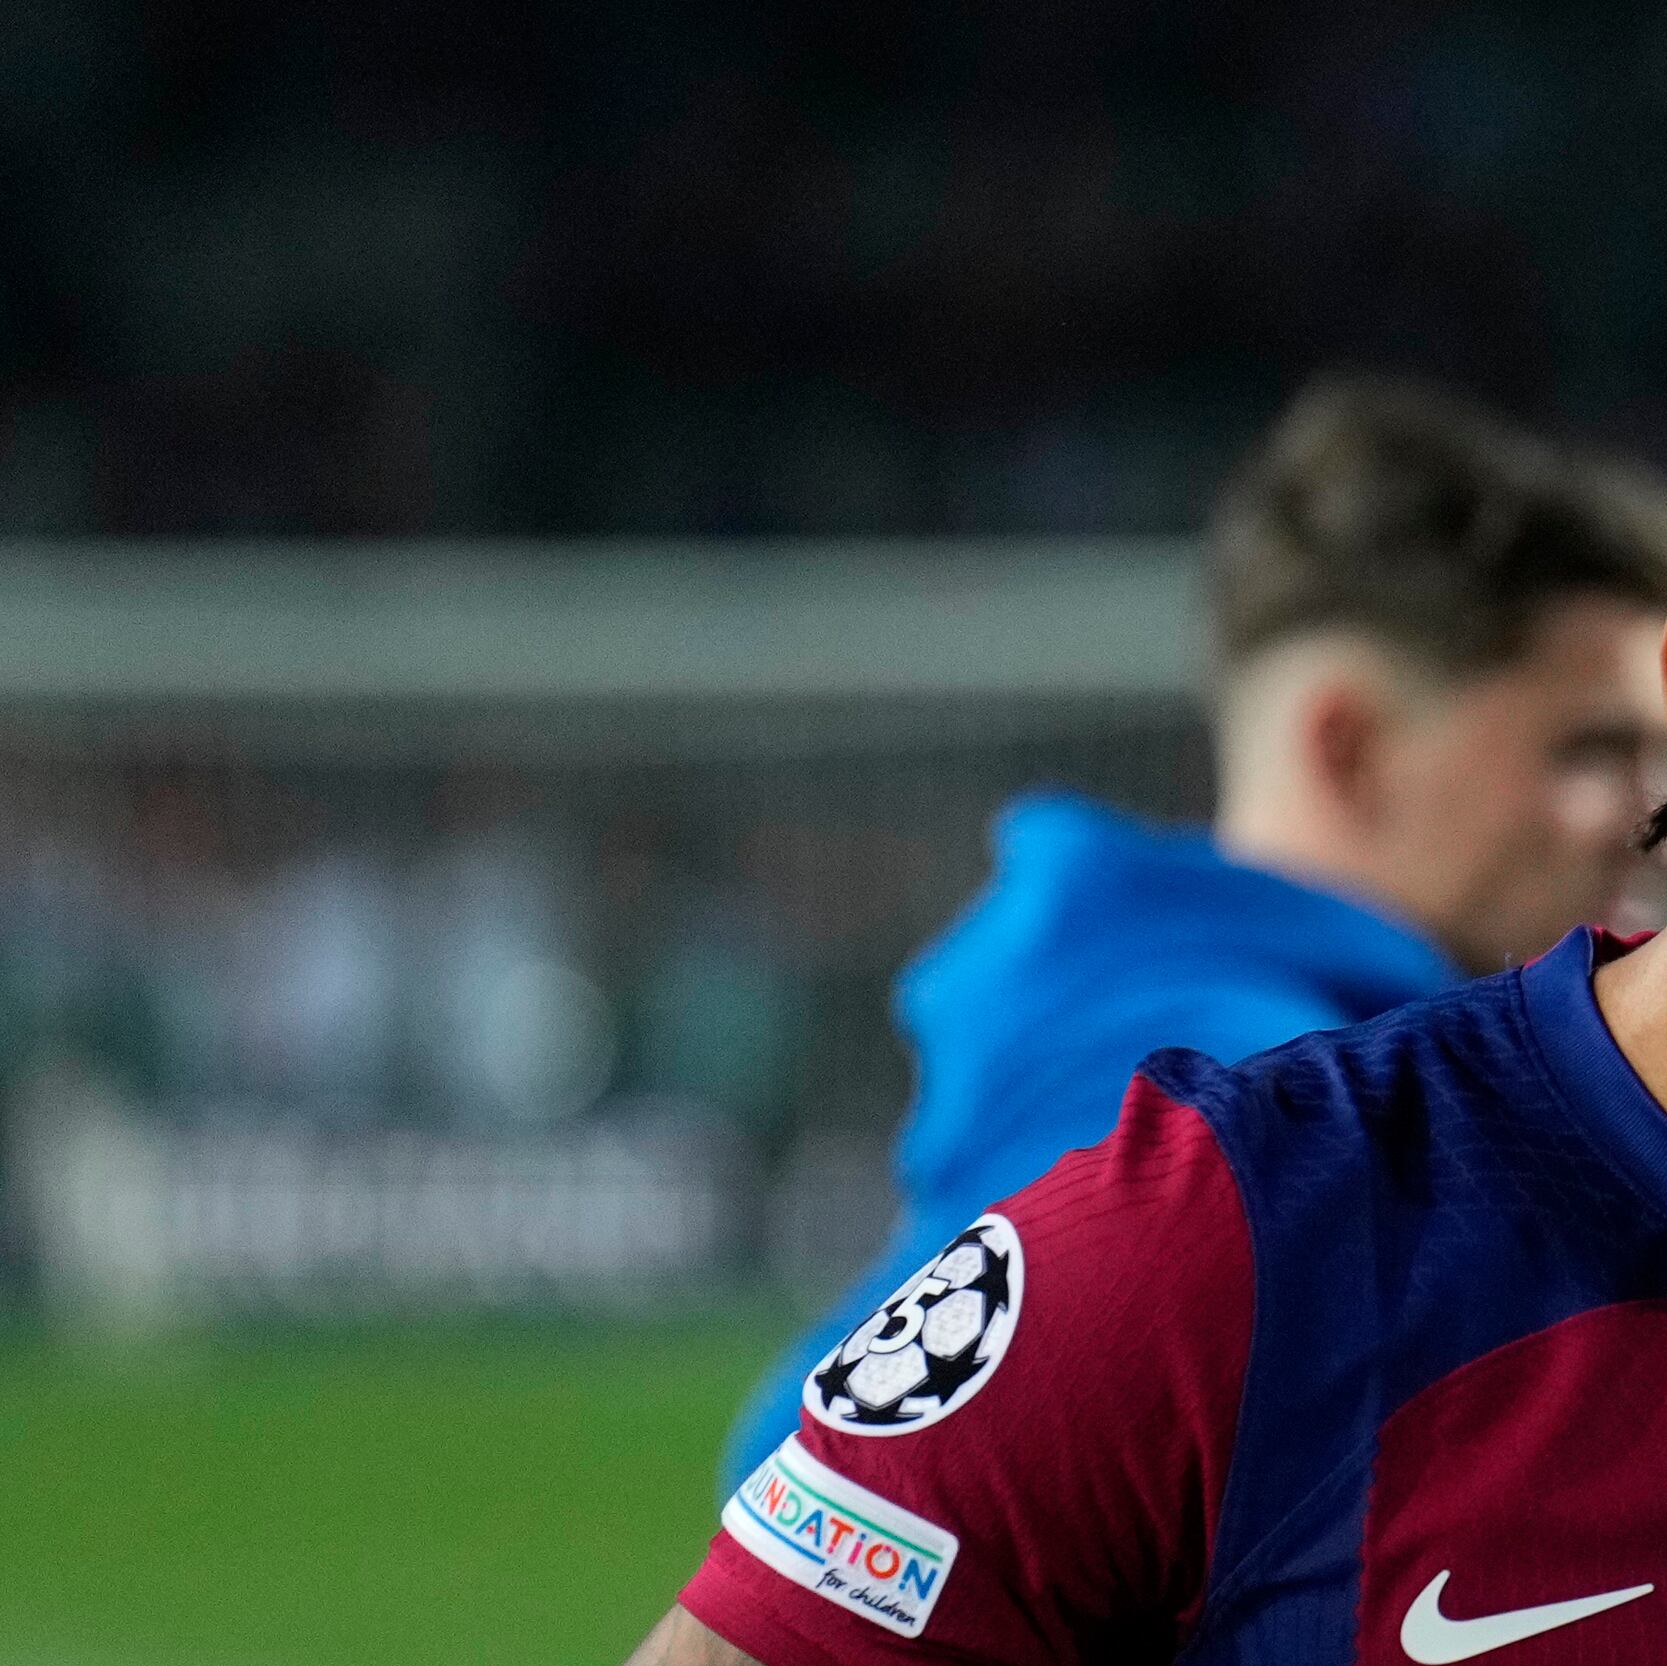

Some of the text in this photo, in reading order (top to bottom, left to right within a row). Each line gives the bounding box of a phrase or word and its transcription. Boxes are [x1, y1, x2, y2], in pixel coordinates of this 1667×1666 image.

[868, 1277, 951, 1354] 5
[815, 1568, 917, 1628] for children
